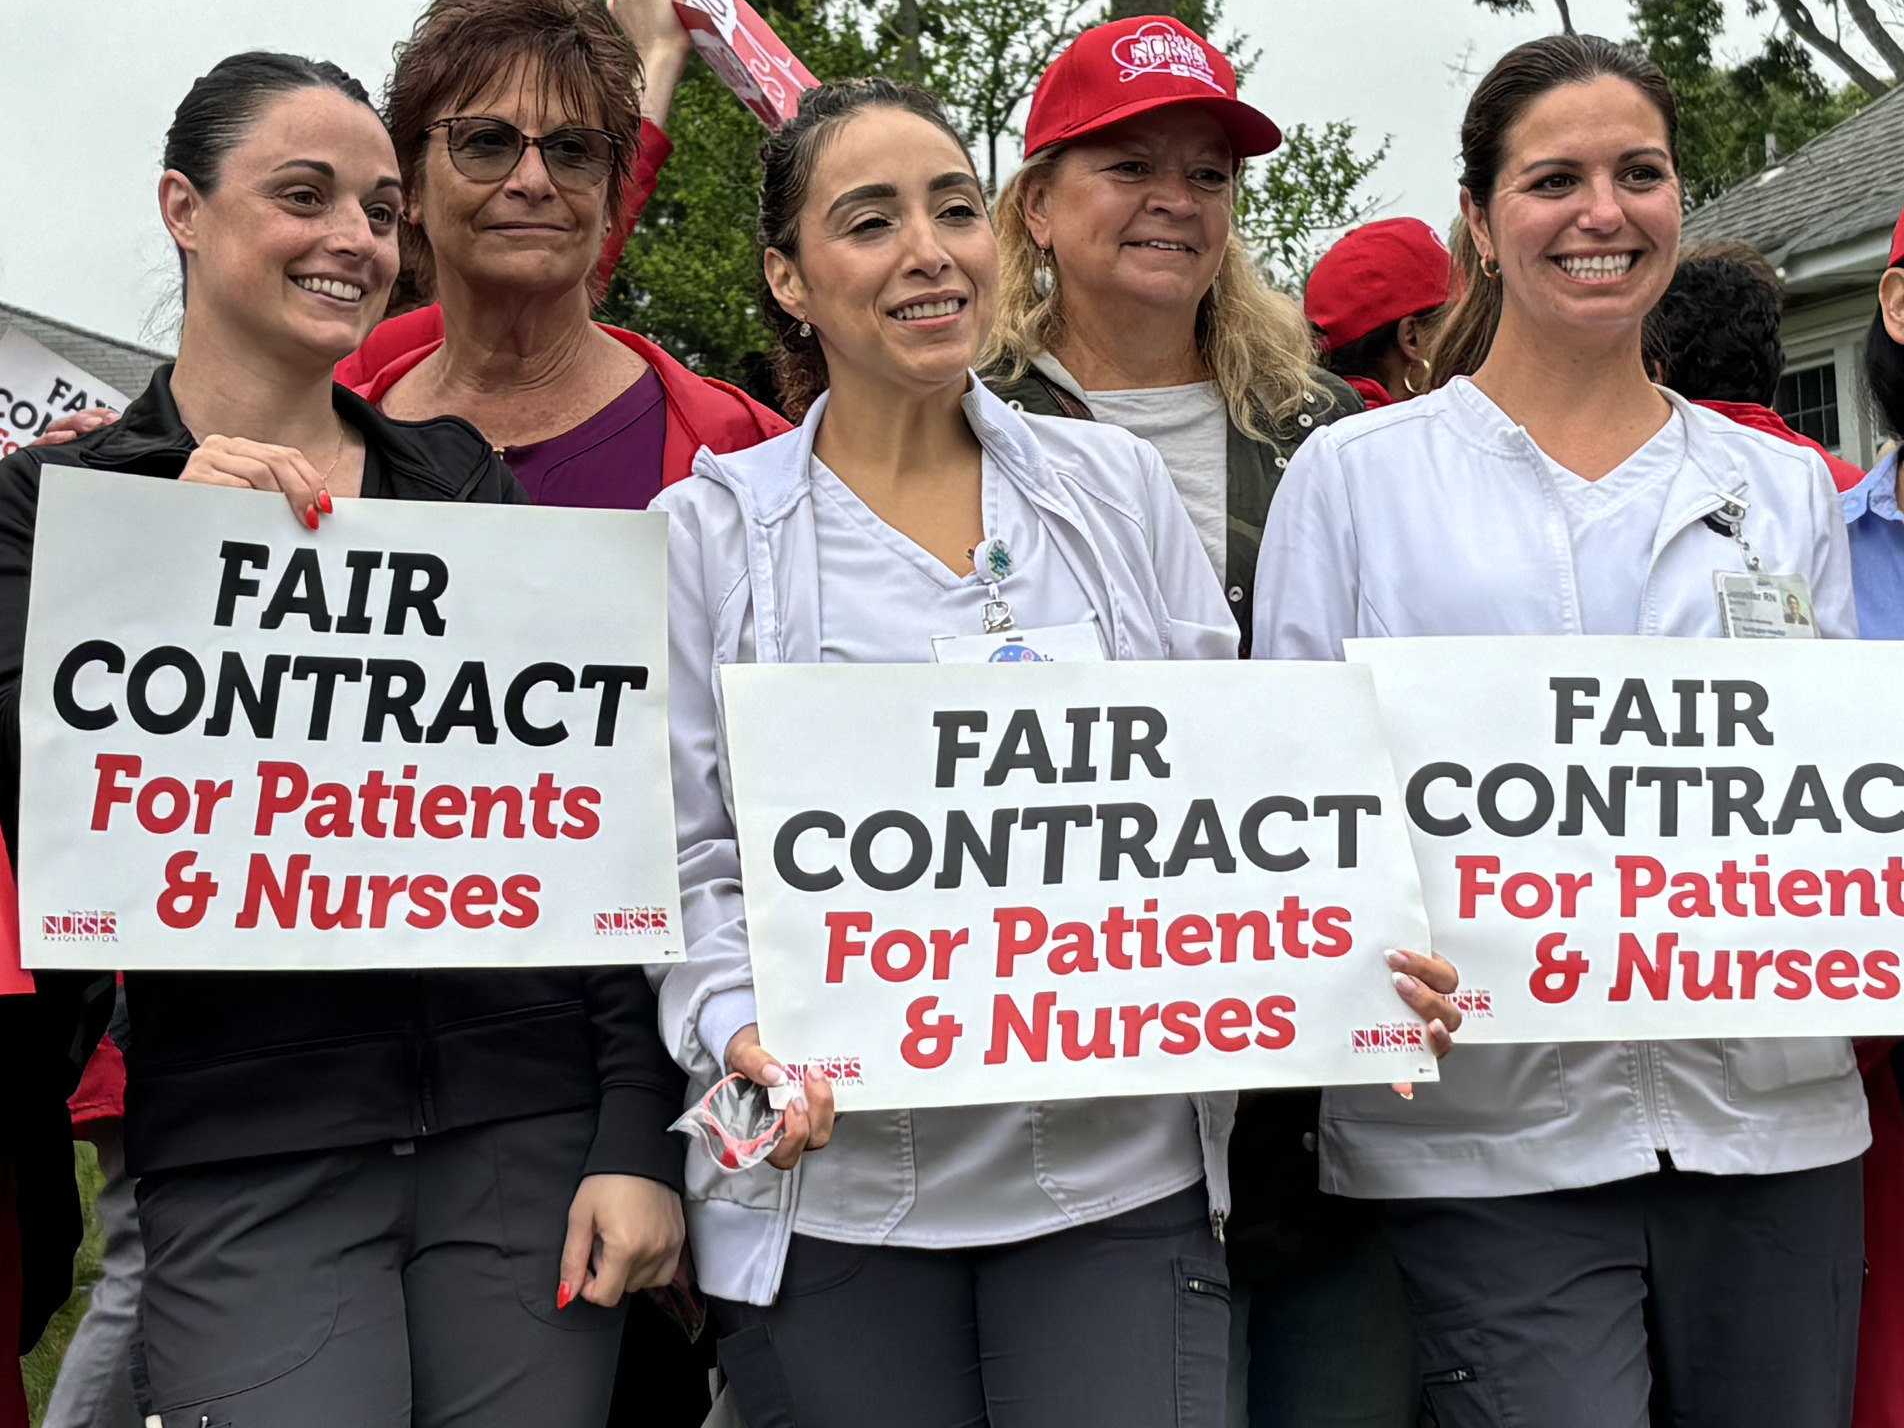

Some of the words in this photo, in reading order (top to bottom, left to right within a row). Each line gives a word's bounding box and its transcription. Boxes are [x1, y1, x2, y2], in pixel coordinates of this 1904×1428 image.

[214, 541, 448, 636] FAIR
[53, 640, 648, 746] CONTRACT
[1550, 678, 1773, 746] FAIR
[933, 707, 1170, 787] FAIR
[92, 754, 232, 834] For
[256, 762, 600, 840] Patients
[774, 795, 1381, 891] CONTRACT
[42, 914, 117, 935] NURSES
[158, 852, 218, 928] &
[236, 854, 540, 930] Nurses
[594, 911, 668, 931] NURSES
[1456, 856, 1592, 918] For
[826, 912, 968, 982] For
[994, 898, 1352, 977] Patients
[1530, 934, 1588, 1004] &
[1610, 934, 1900, 1002] Nurses
[902, 996, 962, 1069] &
[984, 992, 1296, 1064] Nurses
[1352, 1026, 1424, 1048] NURSES
